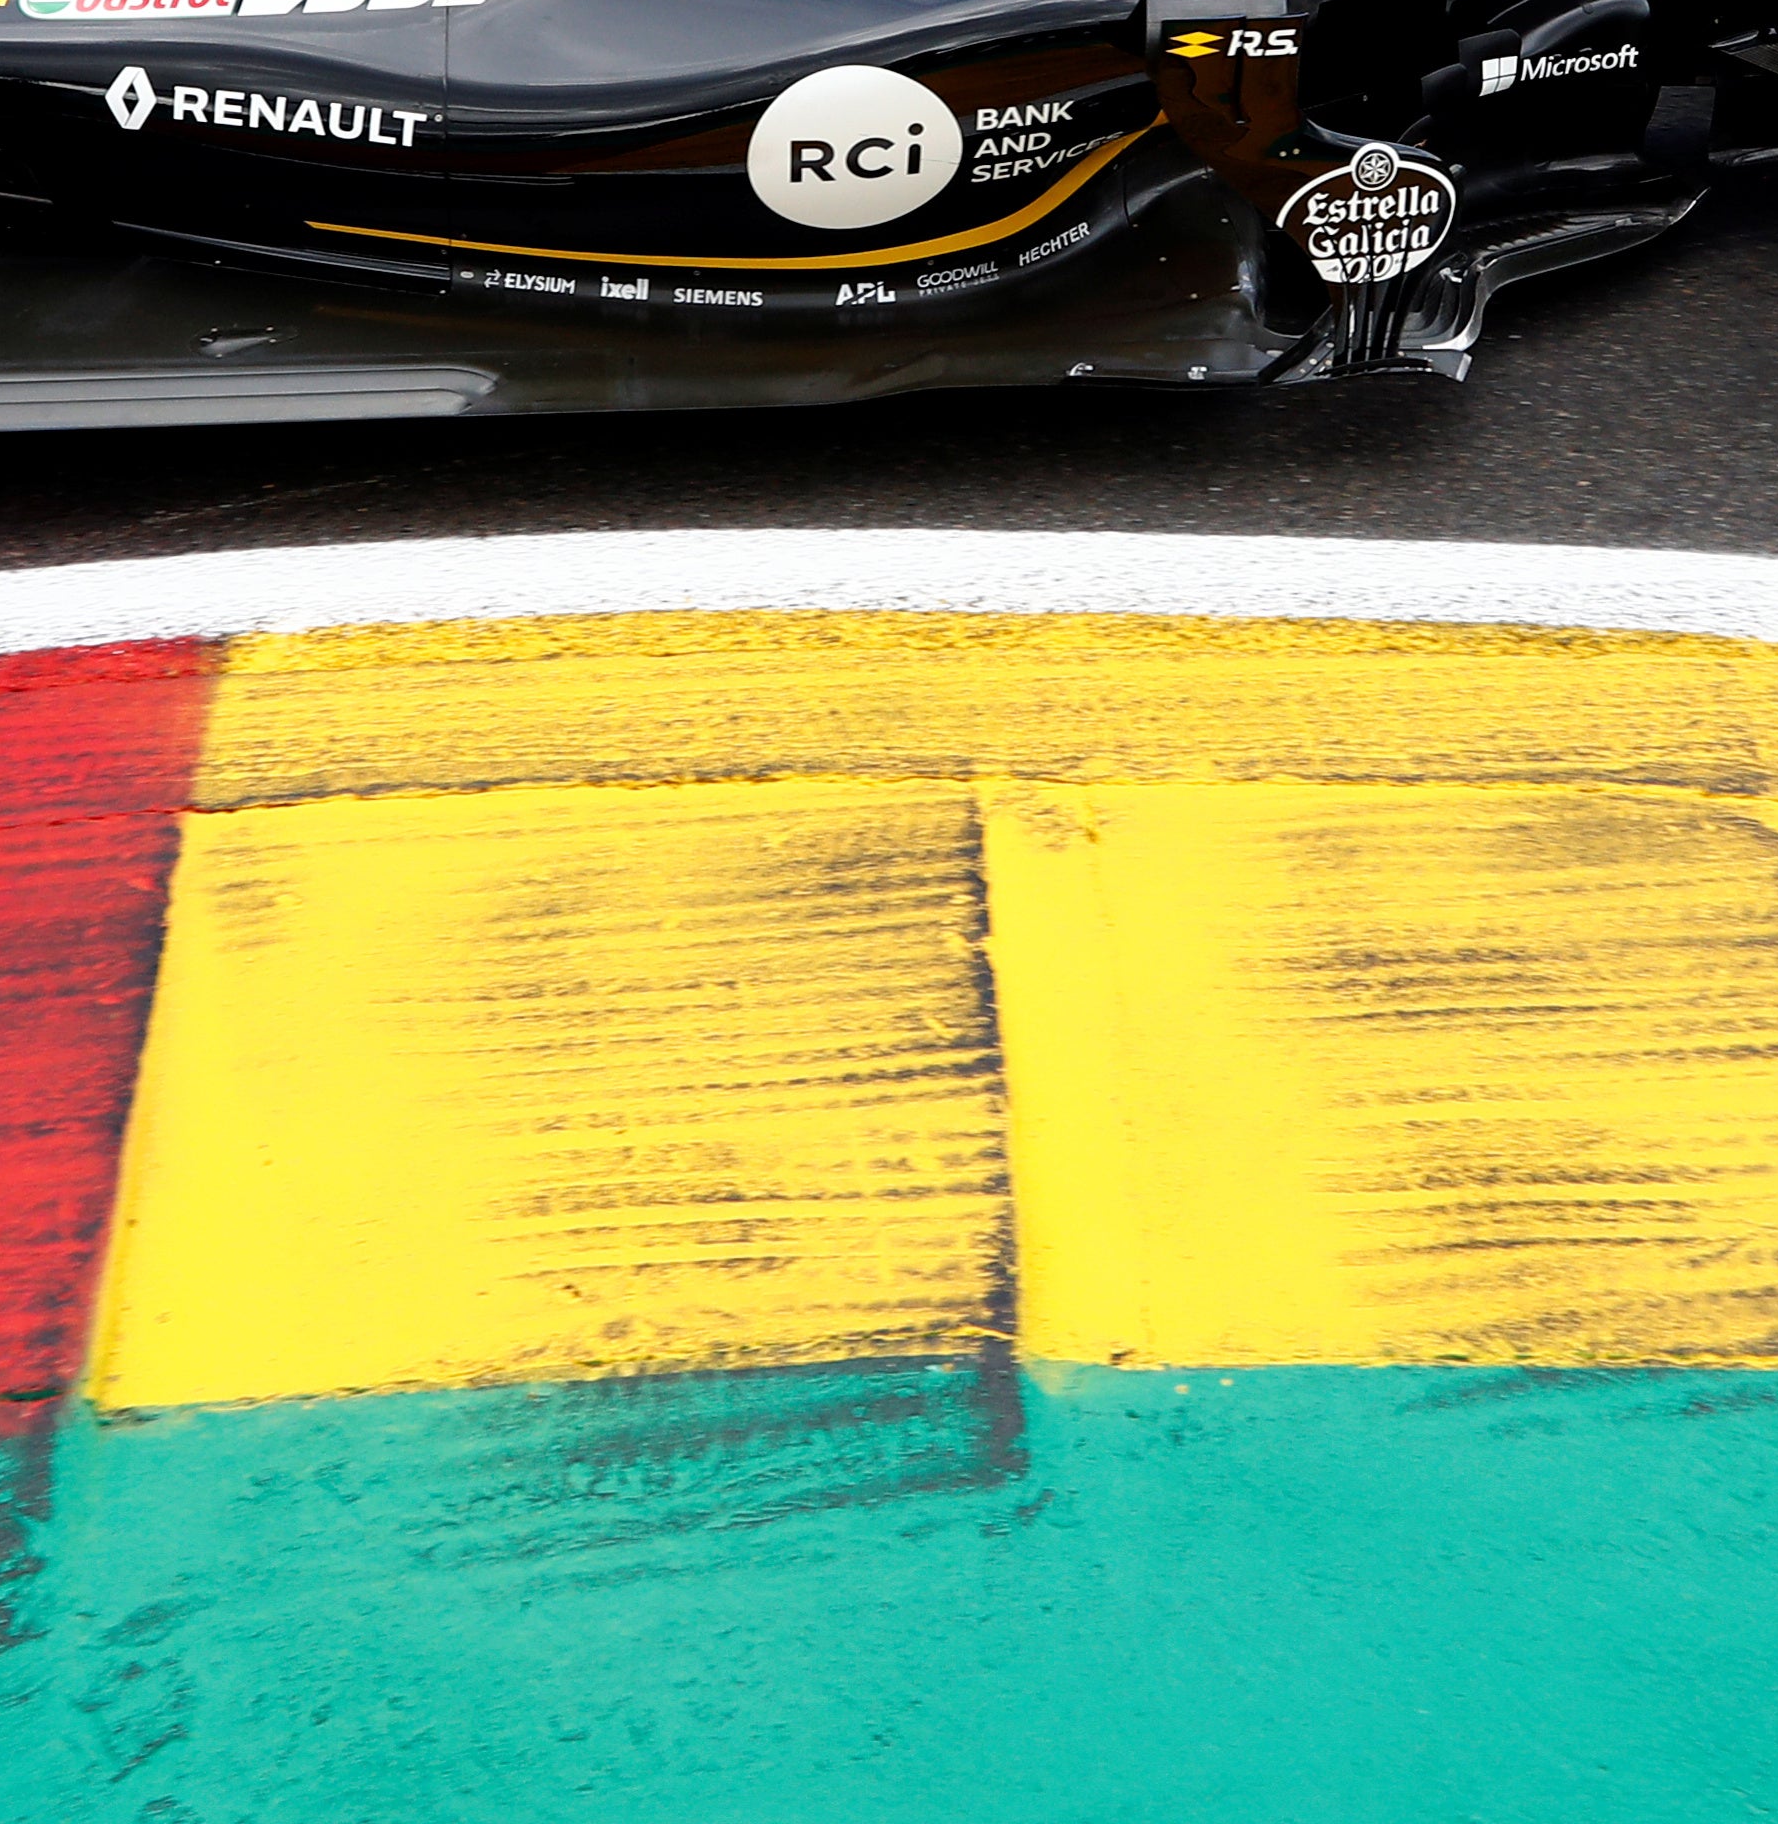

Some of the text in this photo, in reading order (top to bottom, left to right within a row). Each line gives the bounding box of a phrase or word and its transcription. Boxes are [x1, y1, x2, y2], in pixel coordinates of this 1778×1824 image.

[1522, 45, 1639, 82] Microsoft
[173, 85, 427, 147] RENAULT
[975, 101, 1074, 131] BANK
[971, 131, 1124, 183] SERVICES
[974, 132, 1052, 159] AND
[1302, 185, 1439, 225] Estrella
[1019, 222, 1090, 267] HECHTER
[1308, 219, 1430, 258] Galicia
[504, 273, 575, 295] ELYSIUM
[917, 260, 999, 288] GOODWILL
[674, 288, 763, 306] SIEMENS
[835, 281, 897, 306] APL
